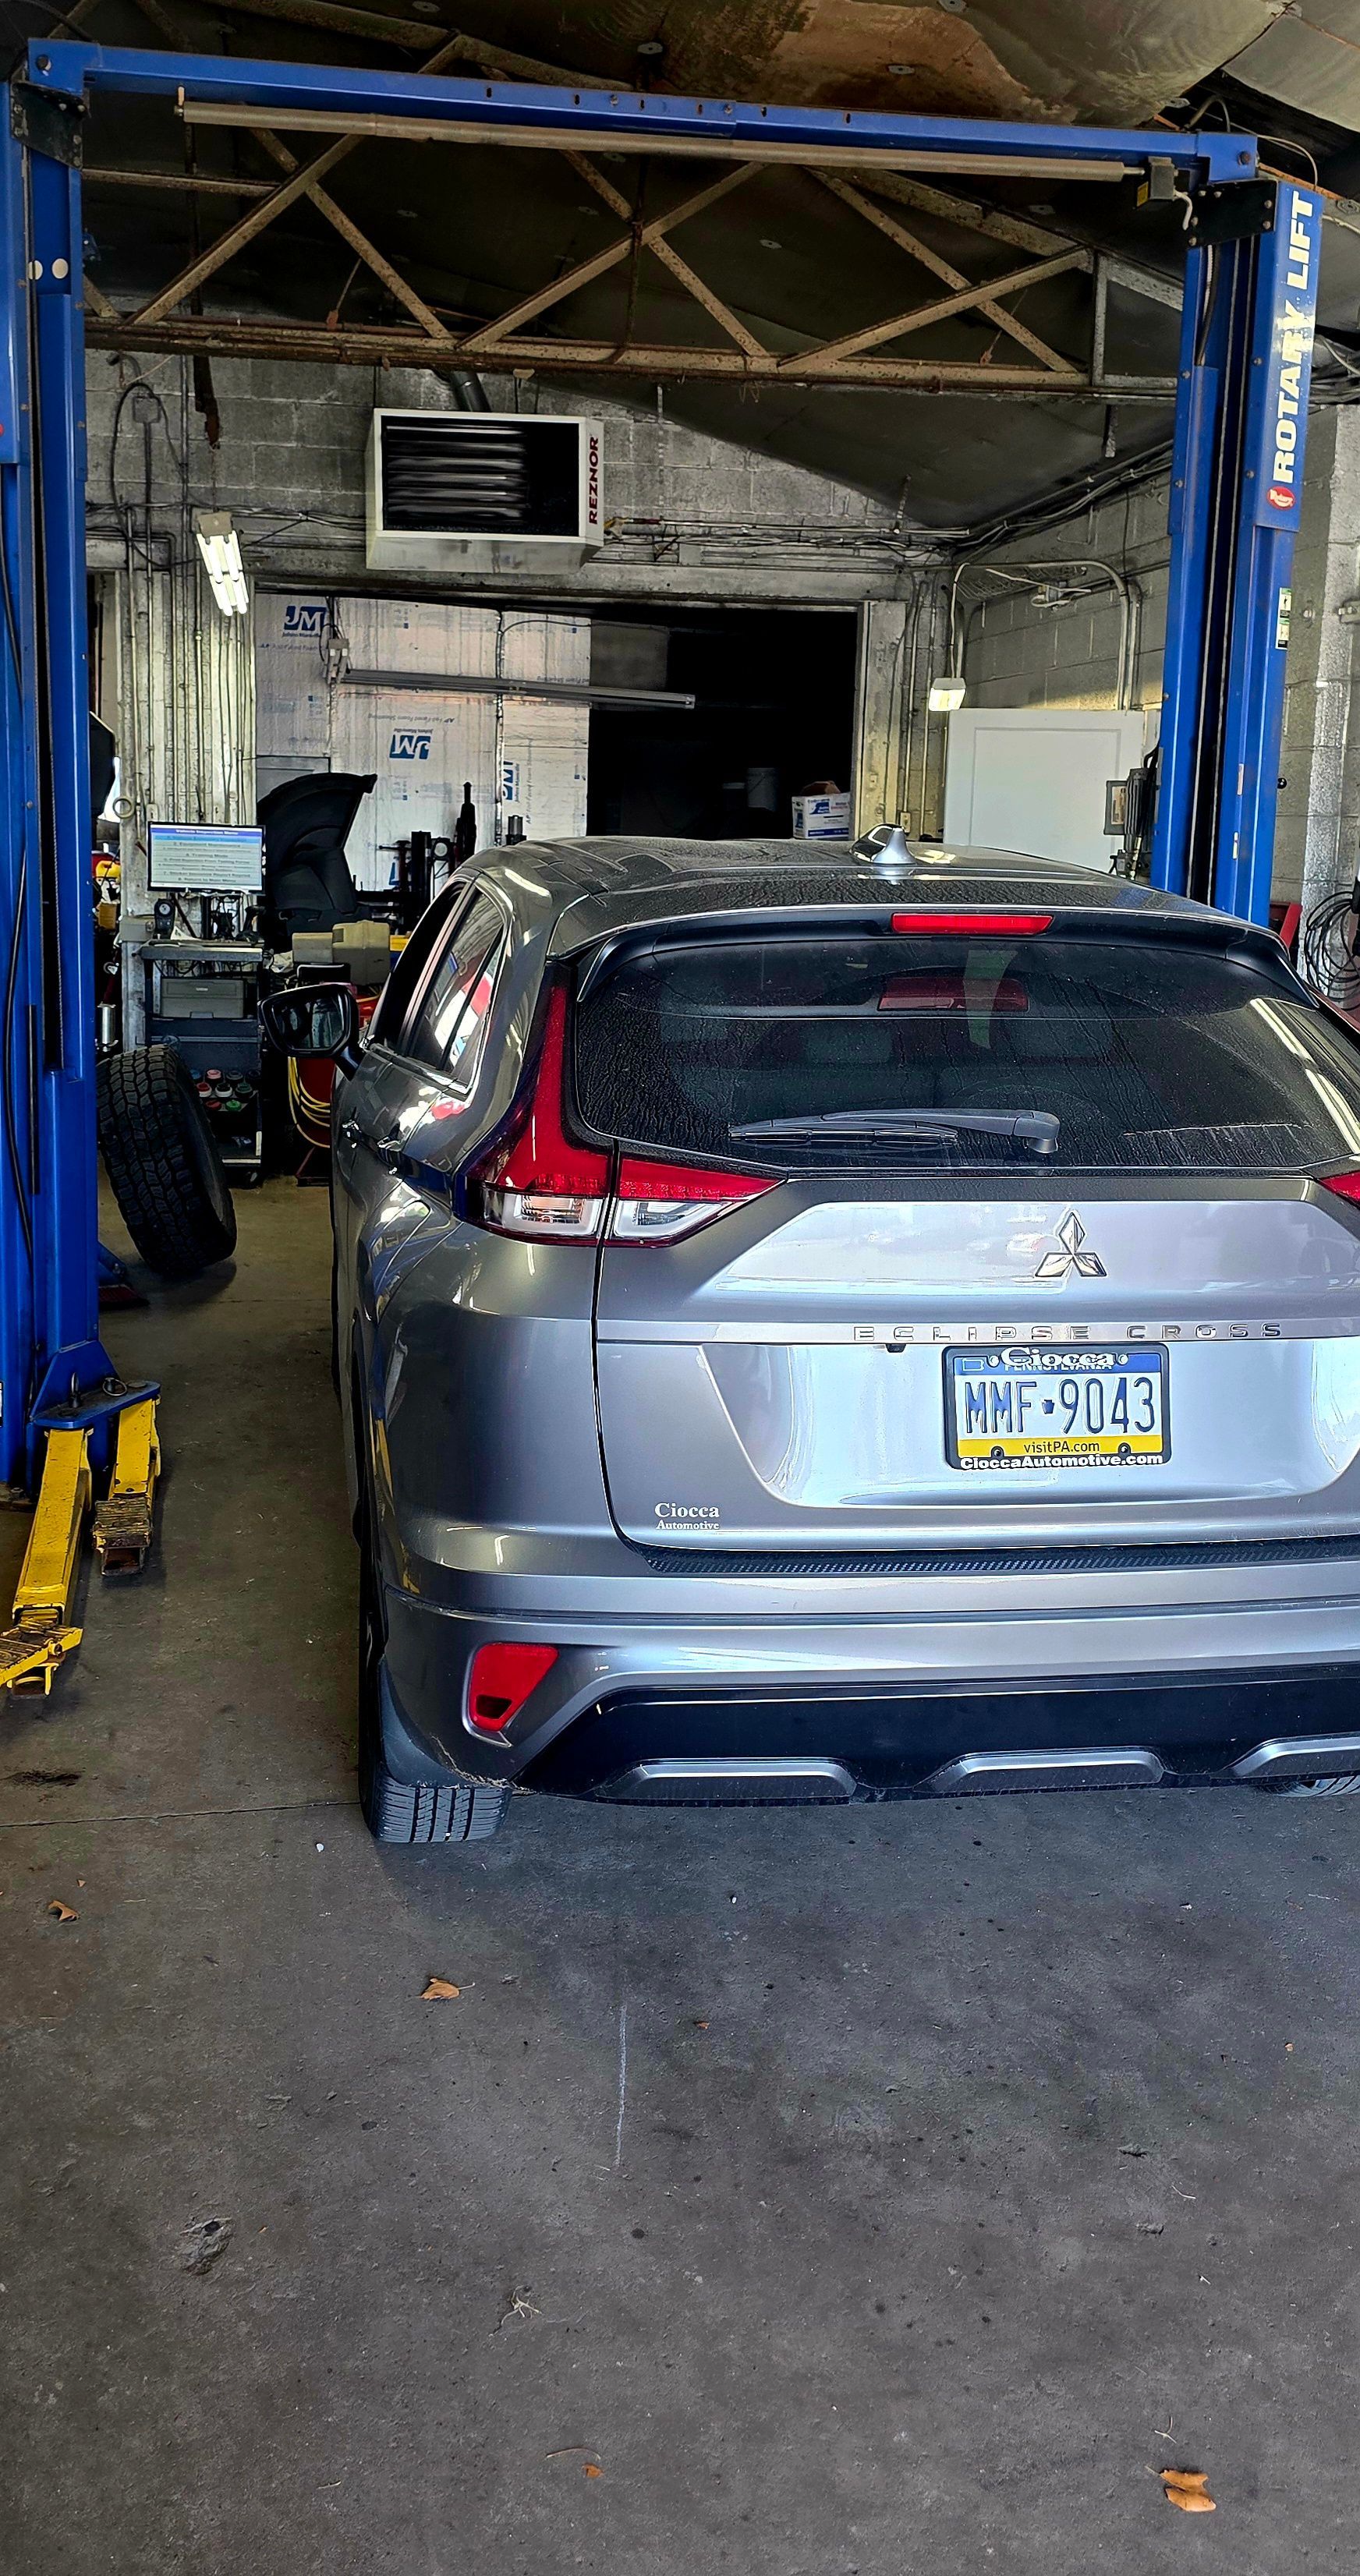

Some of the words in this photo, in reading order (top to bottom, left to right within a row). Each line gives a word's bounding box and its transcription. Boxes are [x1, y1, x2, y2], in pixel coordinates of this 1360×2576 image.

[1287, 189, 1314, 290] LIFT
[1273, 299, 1315, 483] ROTARY
[589, 437, 598, 525] REZNOR
[389, 734, 431, 760] JM
[854, 1325, 1090, 1341] ECLIPSE
[1127, 1322, 1280, 1339] CROSS
[1001, 1346, 1115, 1367] Ciocca
[1024, 1441, 1100, 1454] visitPA.com
[960, 1453, 1163, 1470] CioccaAutomotive.com
[654, 1502, 720, 1518] Ciocca
[656, 1520, 720, 1530] Automotive
